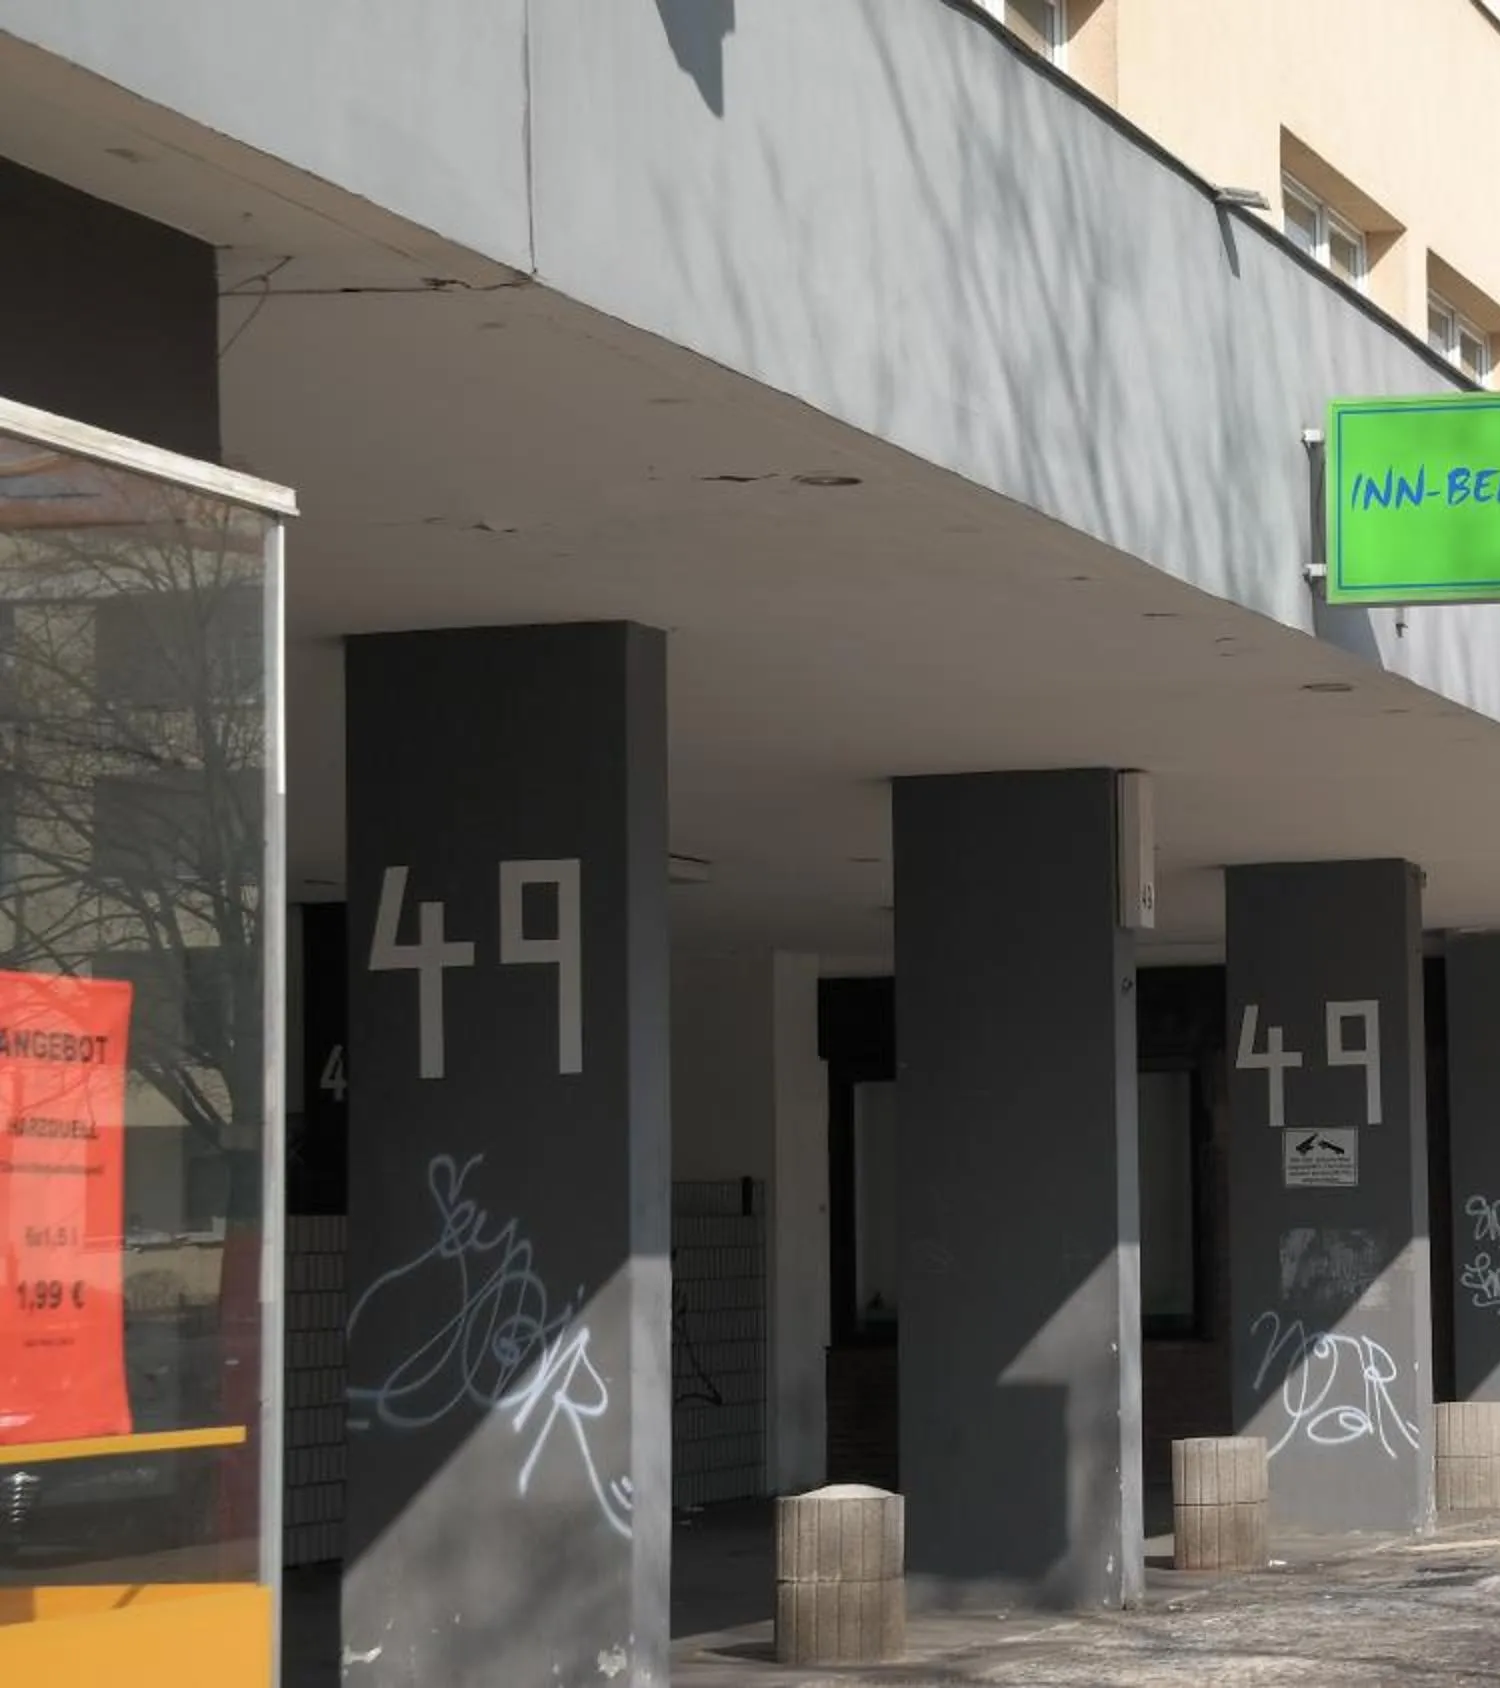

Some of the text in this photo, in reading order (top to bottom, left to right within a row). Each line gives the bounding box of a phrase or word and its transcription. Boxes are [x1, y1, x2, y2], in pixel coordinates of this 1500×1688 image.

[368, 859, 582, 1079] 49
[1236, 1000, 1382, 1126] 49
[16, 1279, 63, 1315] 1,99
